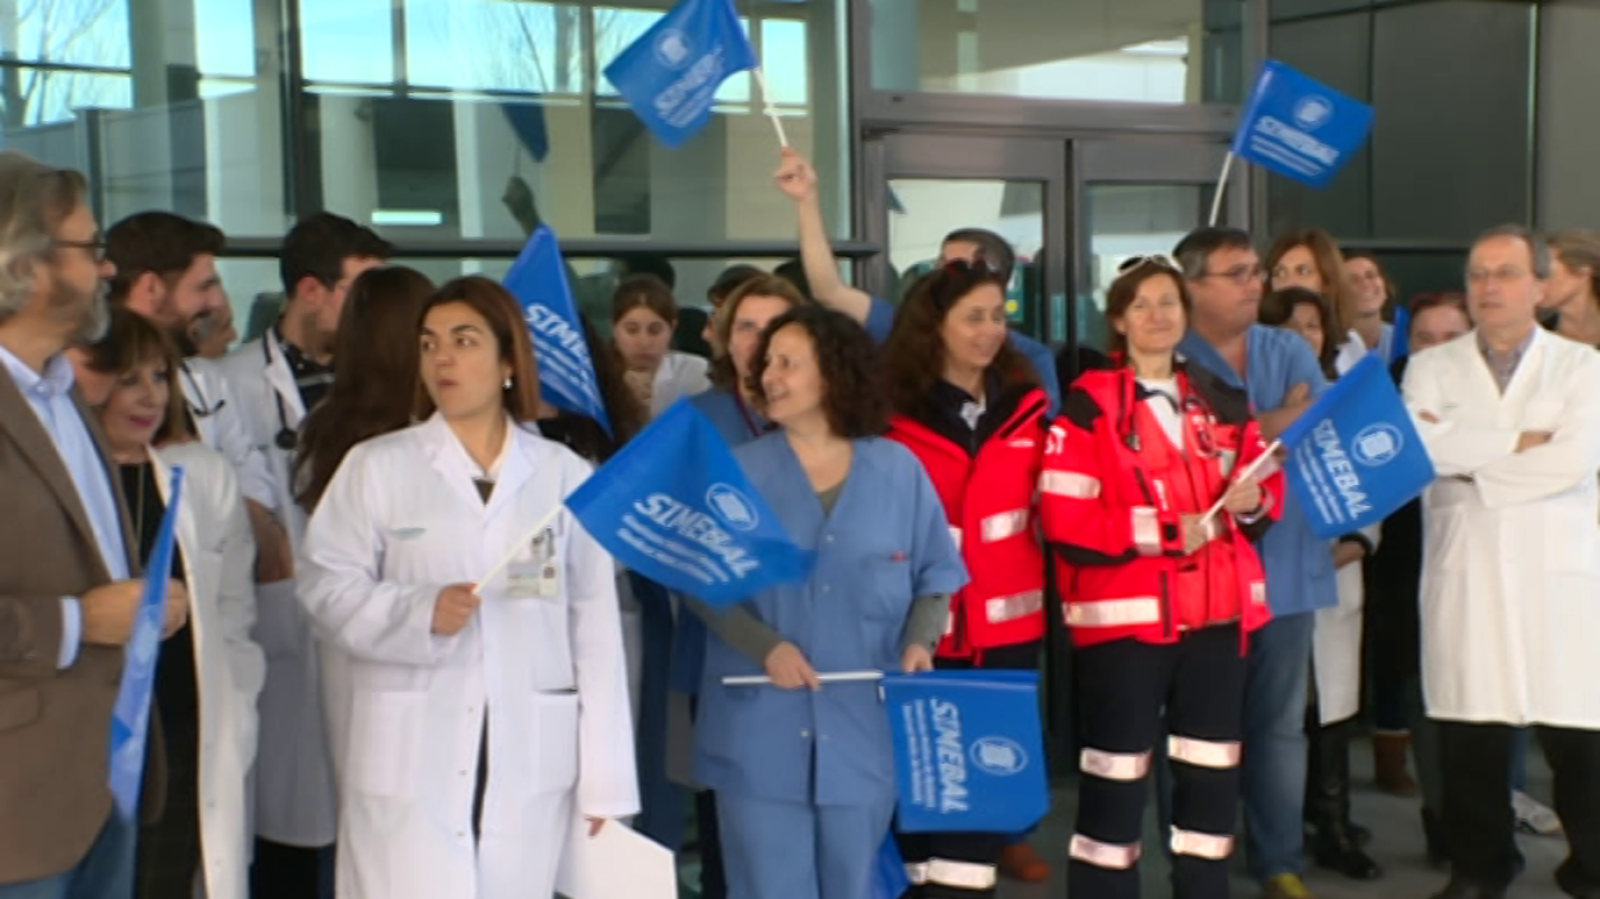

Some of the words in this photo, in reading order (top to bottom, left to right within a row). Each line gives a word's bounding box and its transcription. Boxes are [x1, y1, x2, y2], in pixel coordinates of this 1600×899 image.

[1312, 418, 1373, 521] SIMEBAL
[634, 493, 761, 579] SIMEBAL
[929, 697, 969, 814] SIMEBAL
